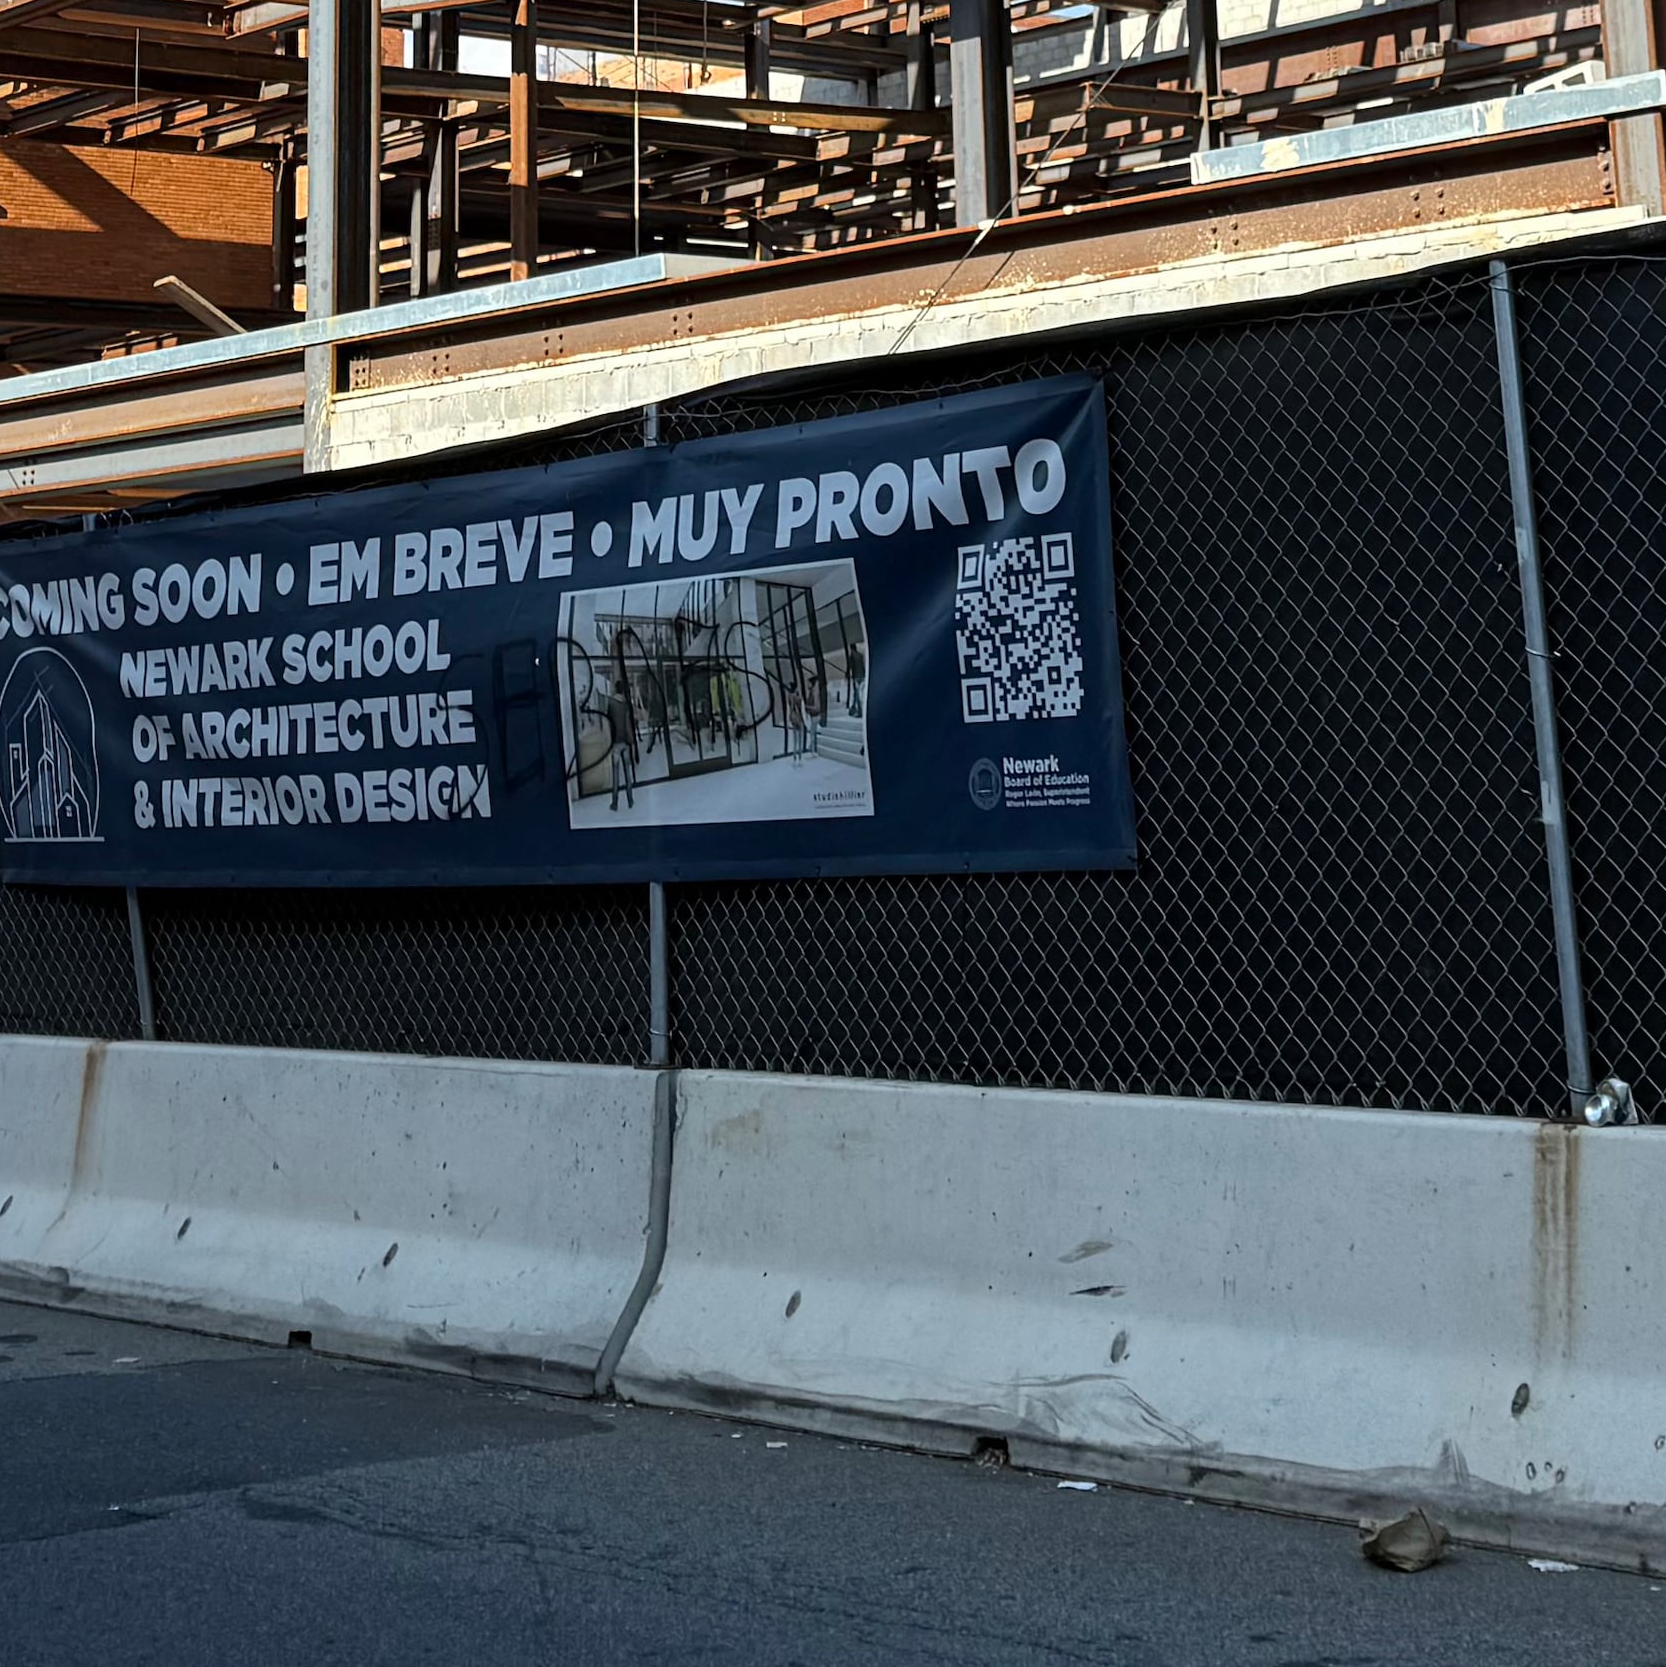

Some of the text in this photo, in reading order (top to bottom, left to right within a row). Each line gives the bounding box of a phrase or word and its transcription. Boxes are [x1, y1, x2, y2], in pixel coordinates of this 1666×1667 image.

[132, 553, 262, 626] SOON
[308, 536, 380, 606] EM
[393, 511, 574, 596] BREVE
[628, 483, 766, 568] MUY
[775, 439, 1066, 549] PRONTO
[120, 619, 451, 698] NEWARK SCHOOL
[133, 690, 477, 762] OF ARCHITECTURE
[134, 764, 492, 828] & INTERIOR DESIGN
[1003, 754, 1060, 774] Newark
[1004, 773, 1090, 788] Board of Education
